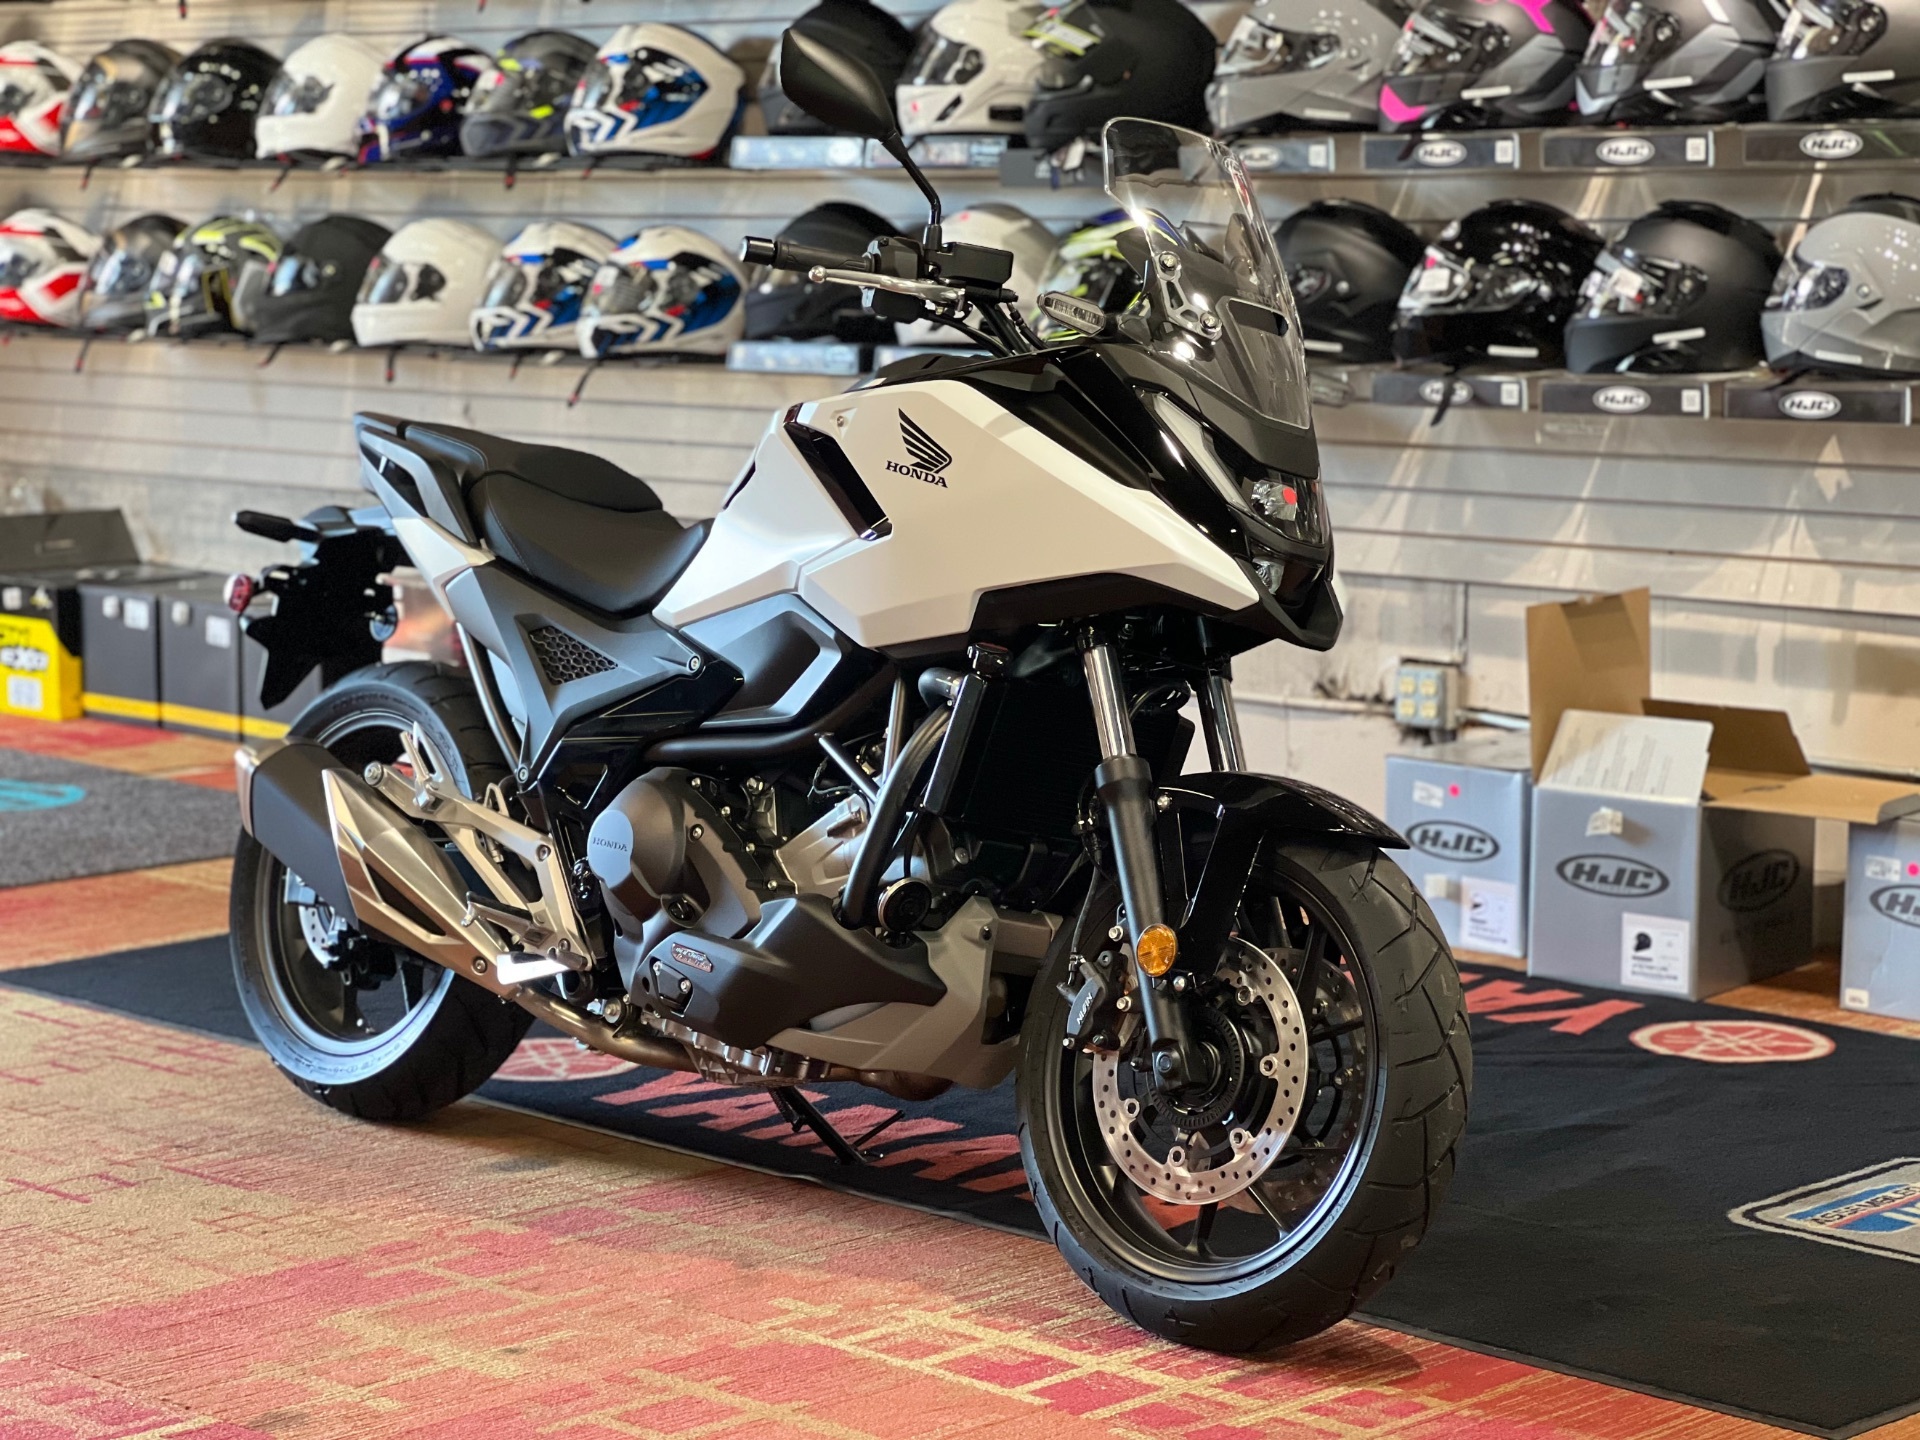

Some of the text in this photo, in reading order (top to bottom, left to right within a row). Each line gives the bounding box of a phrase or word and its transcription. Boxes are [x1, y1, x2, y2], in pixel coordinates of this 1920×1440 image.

[1607, 145, 1647, 156] HJC
[1811, 136, 1857, 151] HJC
[1422, 146, 1459, 158] HJC
[1604, 394, 1641, 405] HJC
[1789, 399, 1831, 411] HJC
[885, 460, 948, 488] HONDA
[592, 836, 628, 852] HONDA
[1417, 828, 1489, 855] HJC
[1570, 861, 1654, 890] HJC
[1728, 859, 1790, 901] HJC
[1884, 892, 1920, 918] H
